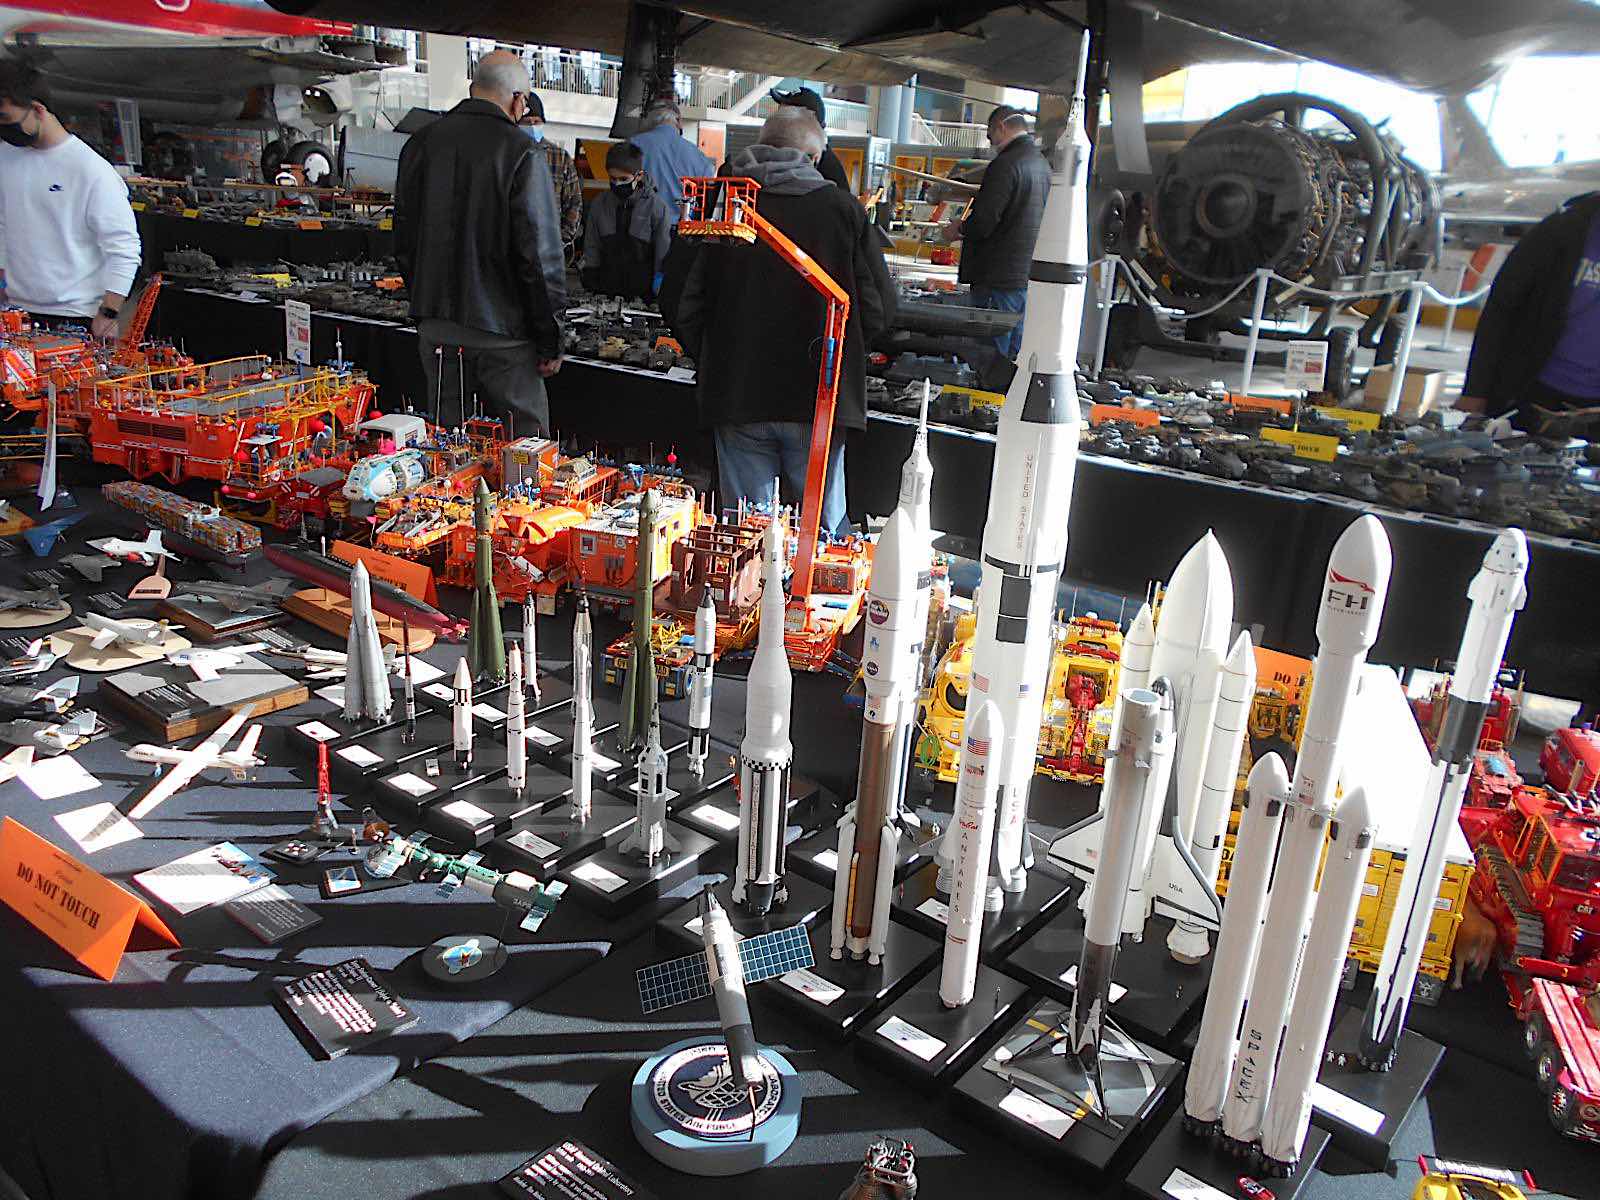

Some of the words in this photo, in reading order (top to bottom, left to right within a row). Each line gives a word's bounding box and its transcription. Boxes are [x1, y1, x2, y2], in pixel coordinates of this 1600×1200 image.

[1274, 672, 1291, 684] DO
[953, 832, 968, 912] ANTARES
[16, 861, 33, 883] DO
[34, 873, 60, 900] NOT
[60, 888, 100, 929] TOUCH
[660, 1098, 687, 1121] STATES
[685, 1119, 704, 1129] AIR
[607, 1174, 635, 1197] Laboratory
